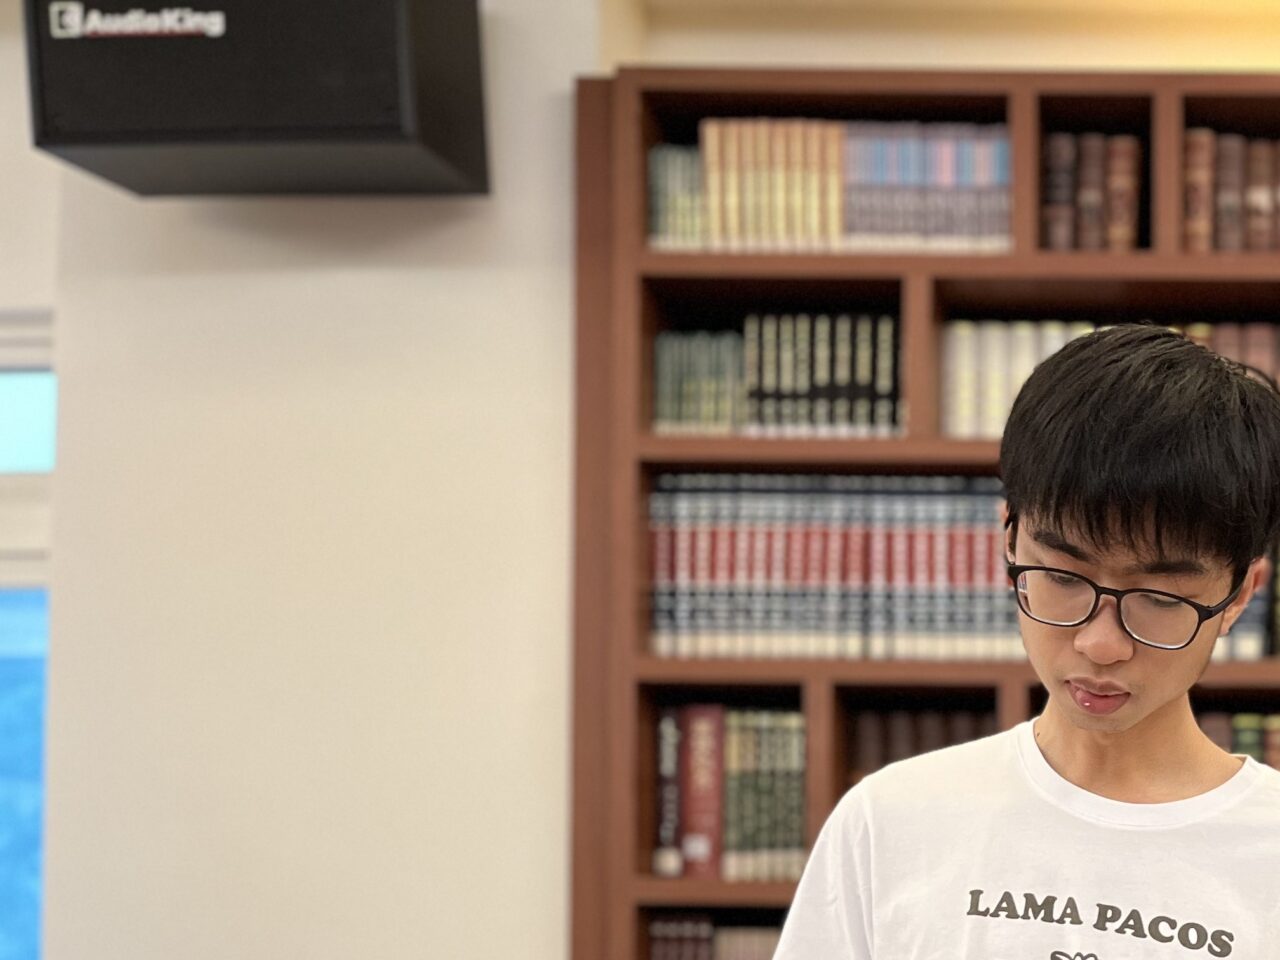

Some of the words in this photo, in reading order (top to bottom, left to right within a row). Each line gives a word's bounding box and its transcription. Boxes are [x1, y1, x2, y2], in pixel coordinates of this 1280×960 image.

[86, 7, 226, 37] AudioKing
[966, 889, 1083, 925] LAMA
[1093, 903, 1234, 958] PACOS
